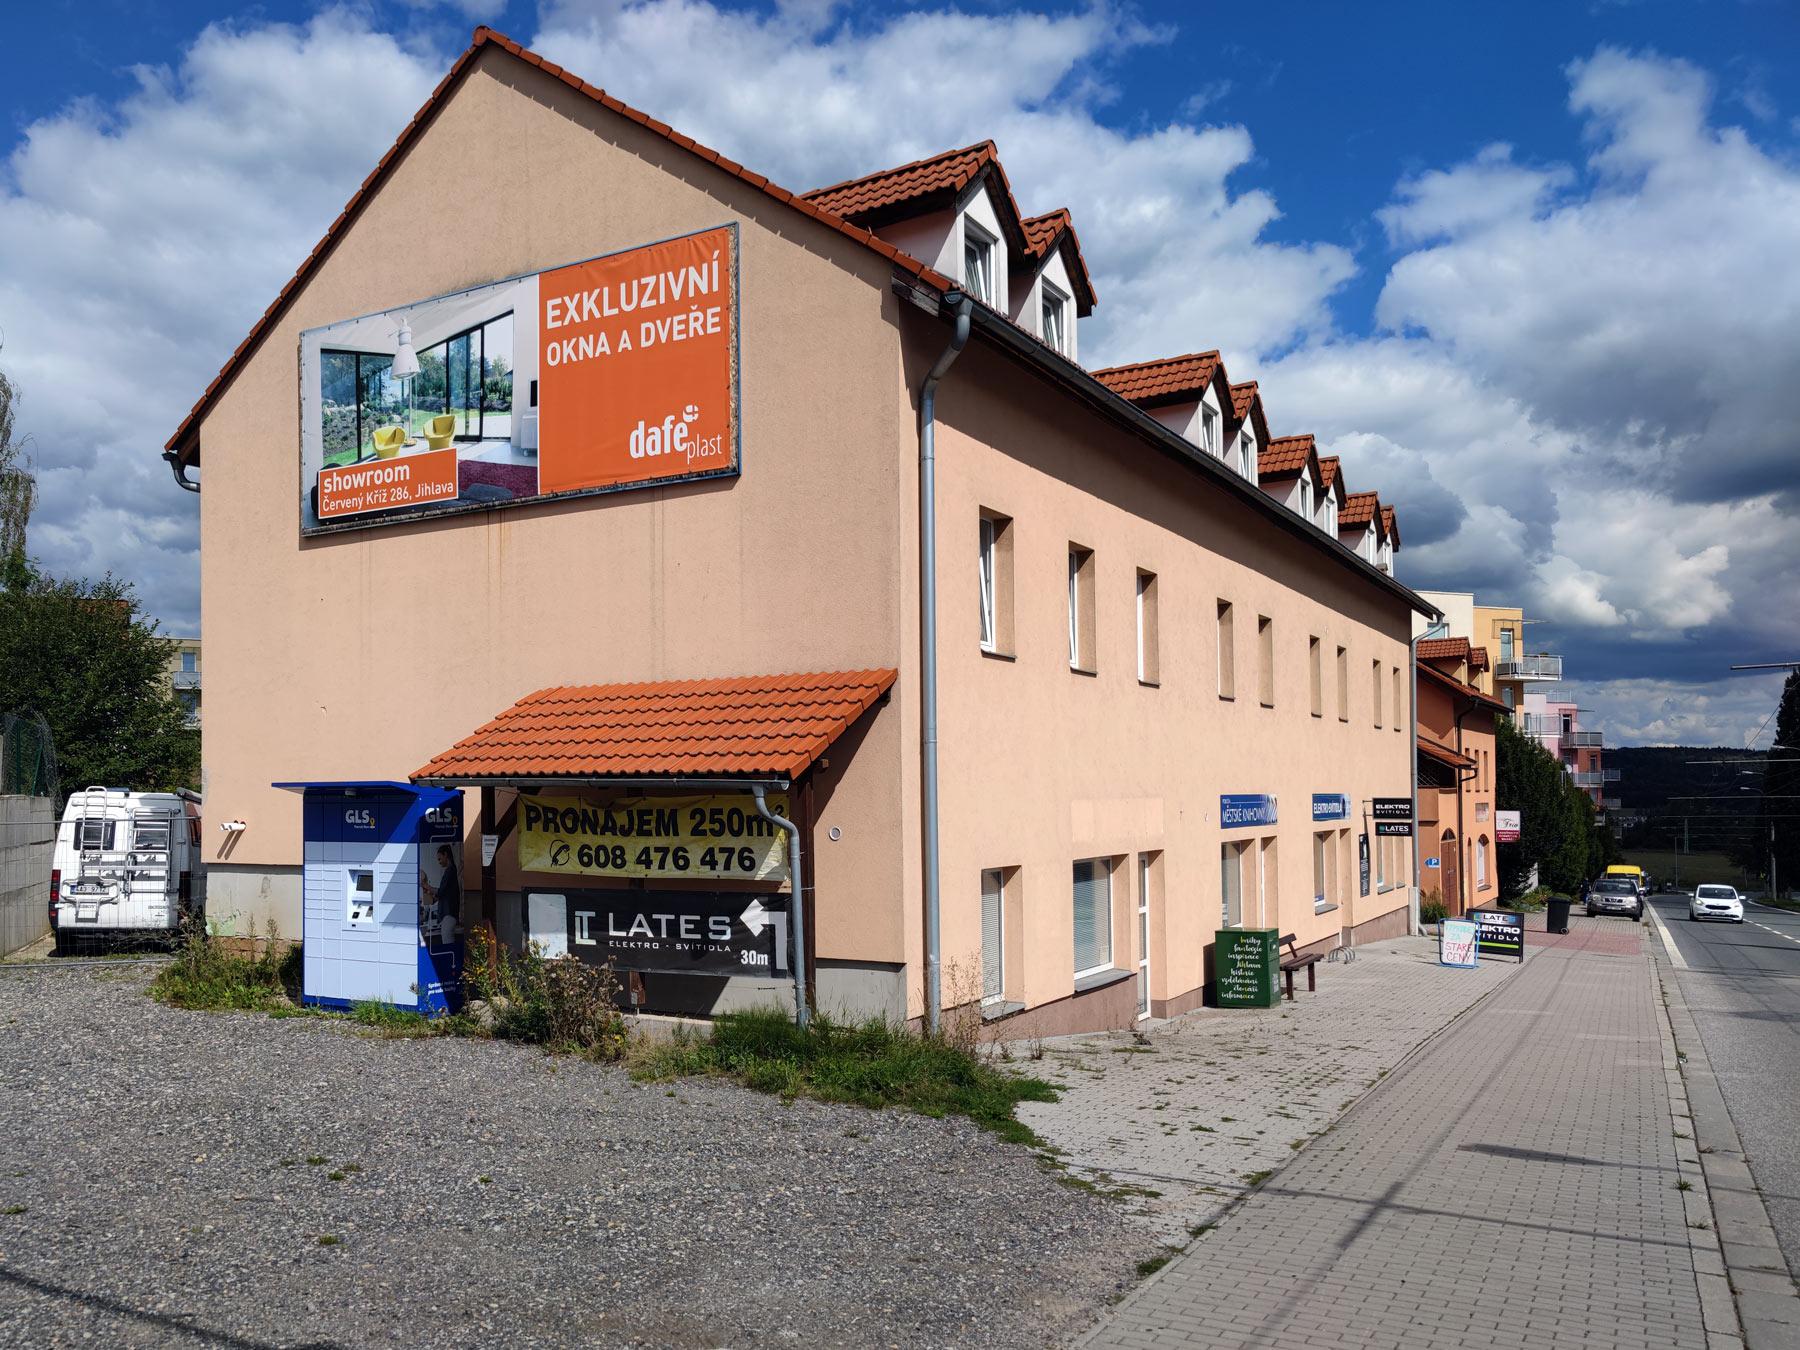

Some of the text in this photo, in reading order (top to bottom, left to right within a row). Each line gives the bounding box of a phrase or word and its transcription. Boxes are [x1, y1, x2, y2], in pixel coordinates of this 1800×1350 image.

[546, 250, 720, 329] EXKLUZIVNÍ
[546, 304, 721, 366] OKNA A DVEŘE
[687, 433, 722, 465] plast
[323, 464, 410, 493] showroom
[322, 480, 454, 512] Červený Kříž 286, Jihlava
[345, 809, 370, 824] GLS
[425, 807, 452, 823] GLS
[577, 844, 756, 872] 608 476 476
[608, 912, 732, 941] LATES
[1475, 924, 1520, 934] LEKTRO
[609, 940, 660, 949] ELEKTRO
[675, 942, 732, 952] SVÍTIDLA
[740, 950, 769, 966] 30m
